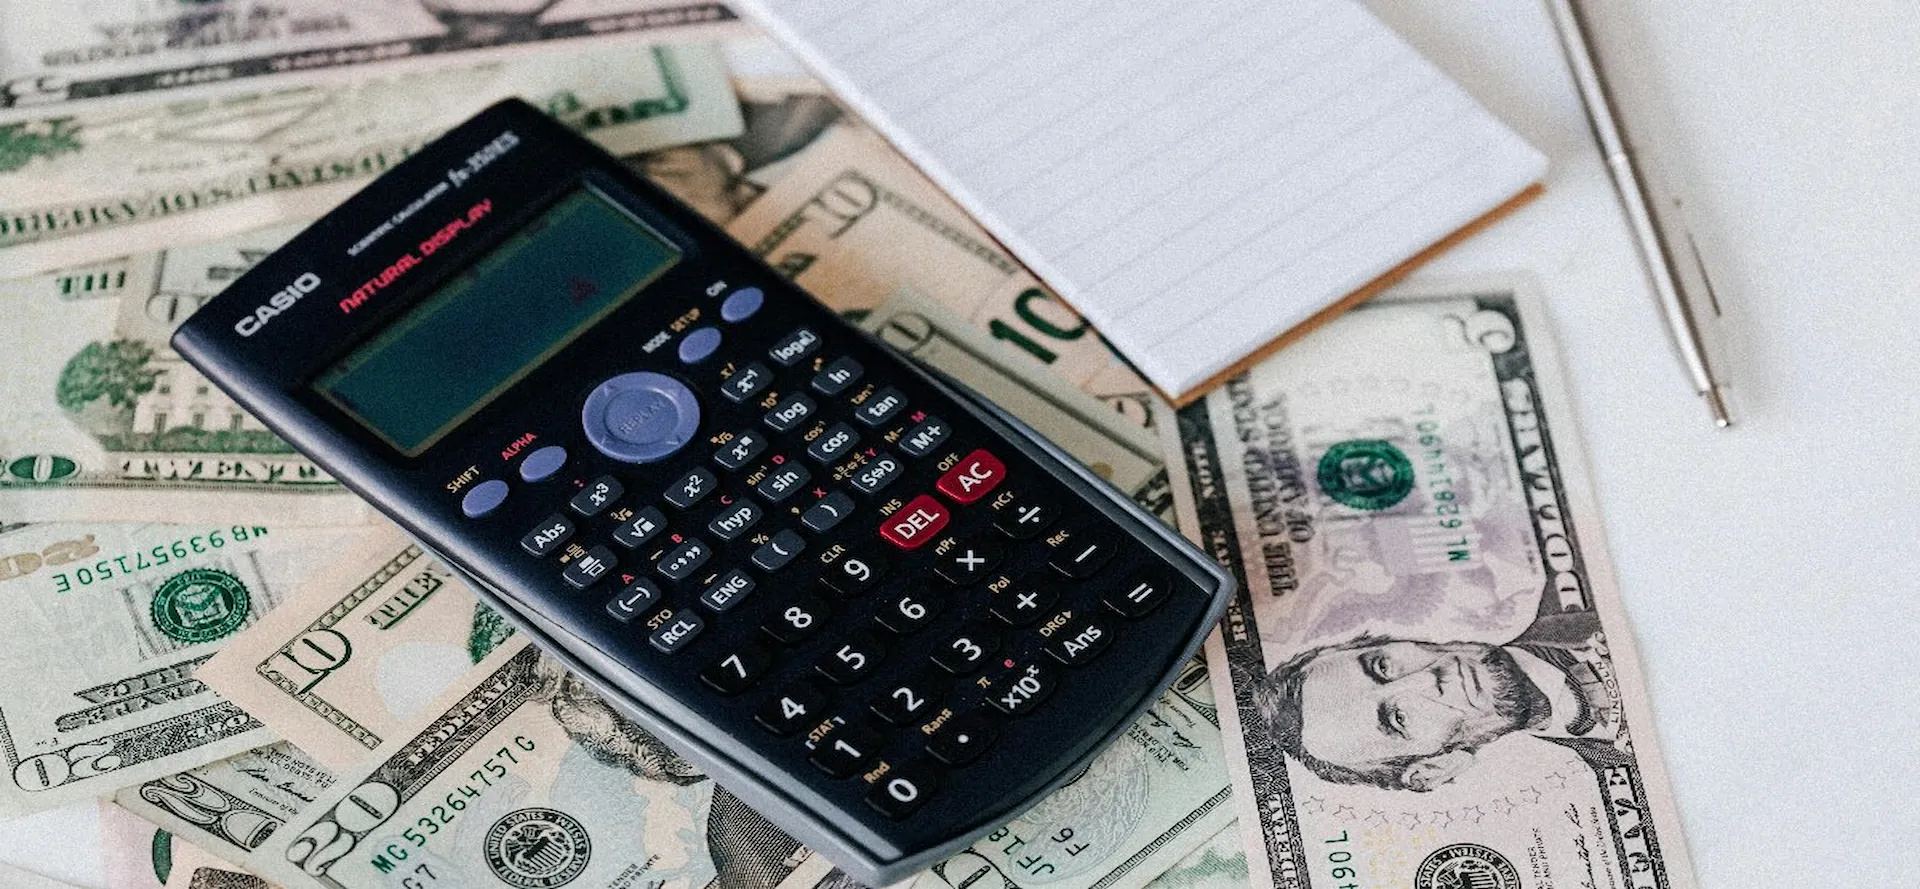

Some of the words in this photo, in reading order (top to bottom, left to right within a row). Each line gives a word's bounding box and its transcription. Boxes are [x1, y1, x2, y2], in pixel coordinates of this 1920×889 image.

[339, 253, 422, 313] NATURAL
[419, 199, 492, 256] DISPLAY
[706, 280, 727, 297] ON
[235, 272, 321, 337] CASIO
[642, 331, 672, 353] MODE
[670, 307, 700, 332] SETUP
[988, 288, 1090, 364] 10
[828, 367, 850, 384] ln
[775, 400, 808, 425] log
[868, 395, 898, 418] tan
[911, 411, 927, 423] M
[501, 432, 538, 461] ALPHA
[821, 431, 849, 454] cos
[910, 424, 942, 450] M+
[1261, 393, 1308, 505] AMERICA
[772, 454, 785, 465] D
[865, 448, 877, 457] Y
[937, 453, 959, 473] OFF
[447, 465, 480, 493] SHIFT
[772, 470, 799, 492] sin
[958, 462, 992, 492] AC
[720, 495, 732, 505] C
[813, 488, 827, 498] X
[991, 491, 1014, 510] nCr
[1243, 448, 1288, 538] UNITED
[1501, 376, 1588, 611] DOLLARS
[718, 507, 752, 531] hyp
[879, 499, 902, 517] INS
[534, 522, 566, 548] Abs
[894, 508, 940, 540] DEL
[1287, 509, 1316, 543] OF
[671, 534, 683, 543] B
[935, 536, 957, 556] nPr
[1046, 529, 1069, 548] Rec
[1446, 534, 1470, 562] ML
[76, 530, 225, 586] 93957150
[820, 545, 845, 563] CLR
[622, 574, 634, 584] A
[844, 559, 870, 581] 9
[1262, 542, 1299, 597] THE
[52, 573, 71, 594] E
[711, 575, 748, 604] ENG
[988, 576, 1010, 594] Pol
[647, 609, 673, 629] STO
[784, 607, 812, 628] 8
[899, 597, 925, 619] 6
[661, 620, 696, 645] RCL
[1063, 625, 1102, 658] Ans
[836, 645, 865, 670] 5
[952, 638, 981, 661] 3
[721, 654, 747, 678] 7
[1004, 659, 1015, 669] e
[892, 687, 924, 711] 2
[1596, 661, 1620, 724] LINCOLN
[781, 697, 806, 719] 4
[187, 712, 250, 742] OTE
[407, 676, 515, 766] FEDERAL
[809, 719, 835, 742] STAT
[921, 708, 952, 735] Ran#
[835, 740, 861, 758] 1
[13, 739, 121, 793] 20
[863, 761, 891, 783] Rnd
[888, 778, 918, 802] 0
[139, 771, 281, 851] 20
[371, 844, 409, 874] MG
[402, 747, 519, 847] 53264757
[515, 735, 535, 752] G
[287, 782, 402, 877] 20
[488, 825, 506, 860] UNITED
[507, 811, 545, 828] STATES
[555, 815, 587, 851] SYSTEM
[1263, 793, 1302, 889] EDERAL
[1324, 830, 1351, 845] L
[1051, 827, 1090, 857] F6
[1016, 855, 1055, 876] JF
[1448, 847, 1496, 863] SYSTEM
[402, 863, 436, 889] G7
[500, 865, 547, 888] FEDERAL
[551, 853, 587, 887] RESERVE
[632, 853, 661, 882] PRIVATE
[1420, 857, 1442, 888] STATES
